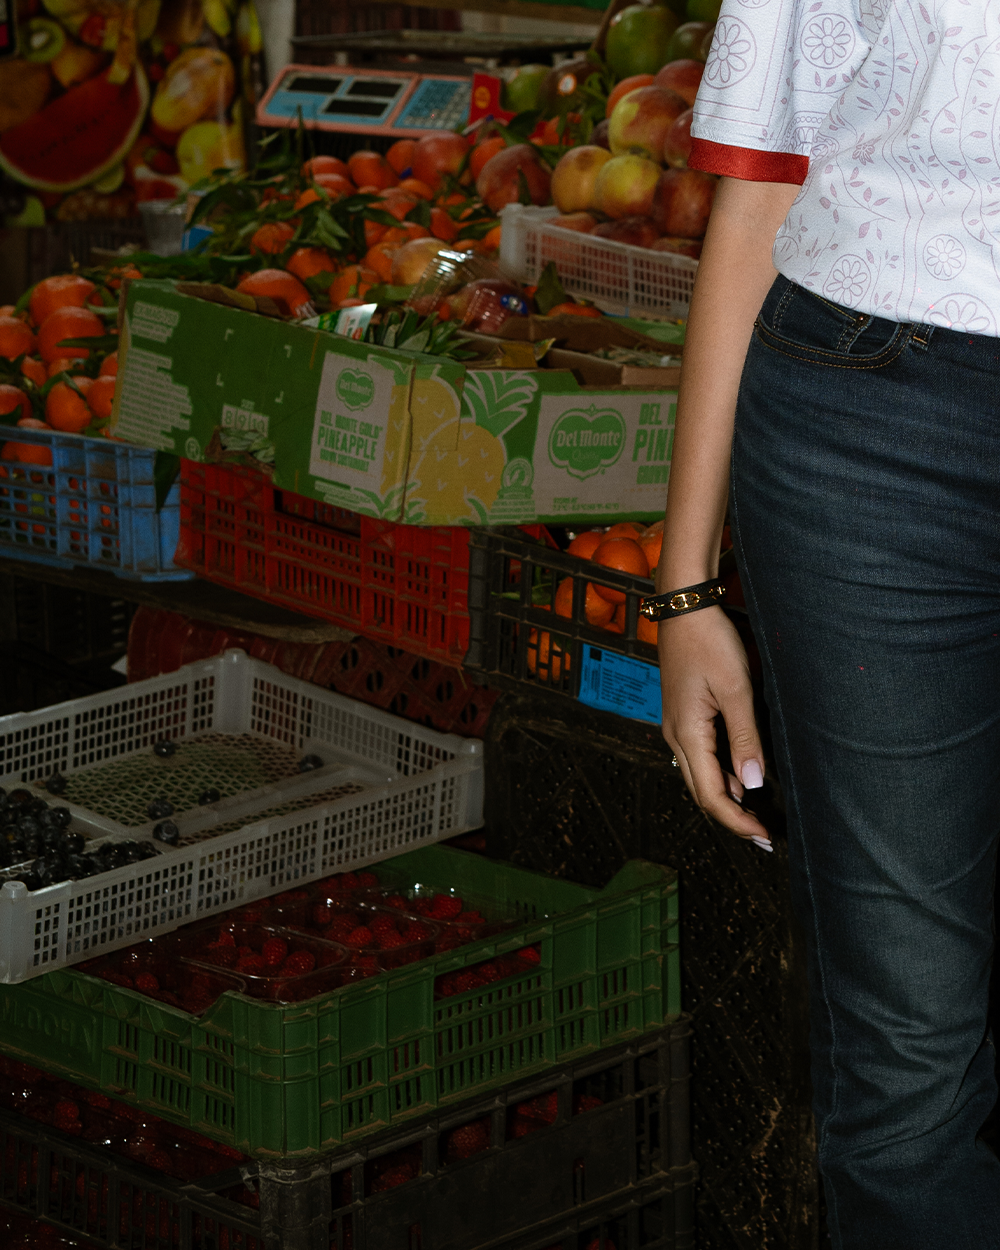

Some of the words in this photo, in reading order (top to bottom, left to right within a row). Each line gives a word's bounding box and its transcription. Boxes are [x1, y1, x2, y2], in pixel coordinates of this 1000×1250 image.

[224, 410, 233, 425] 8
[238, 415, 247, 428] 9
[320, 410, 333, 427] DEL
[639, 403, 662, 425] DEL
[317, 426, 378, 461] PINEAPPLE
[556, 429, 577, 447] Del
[579, 429, 620, 447] Monte
